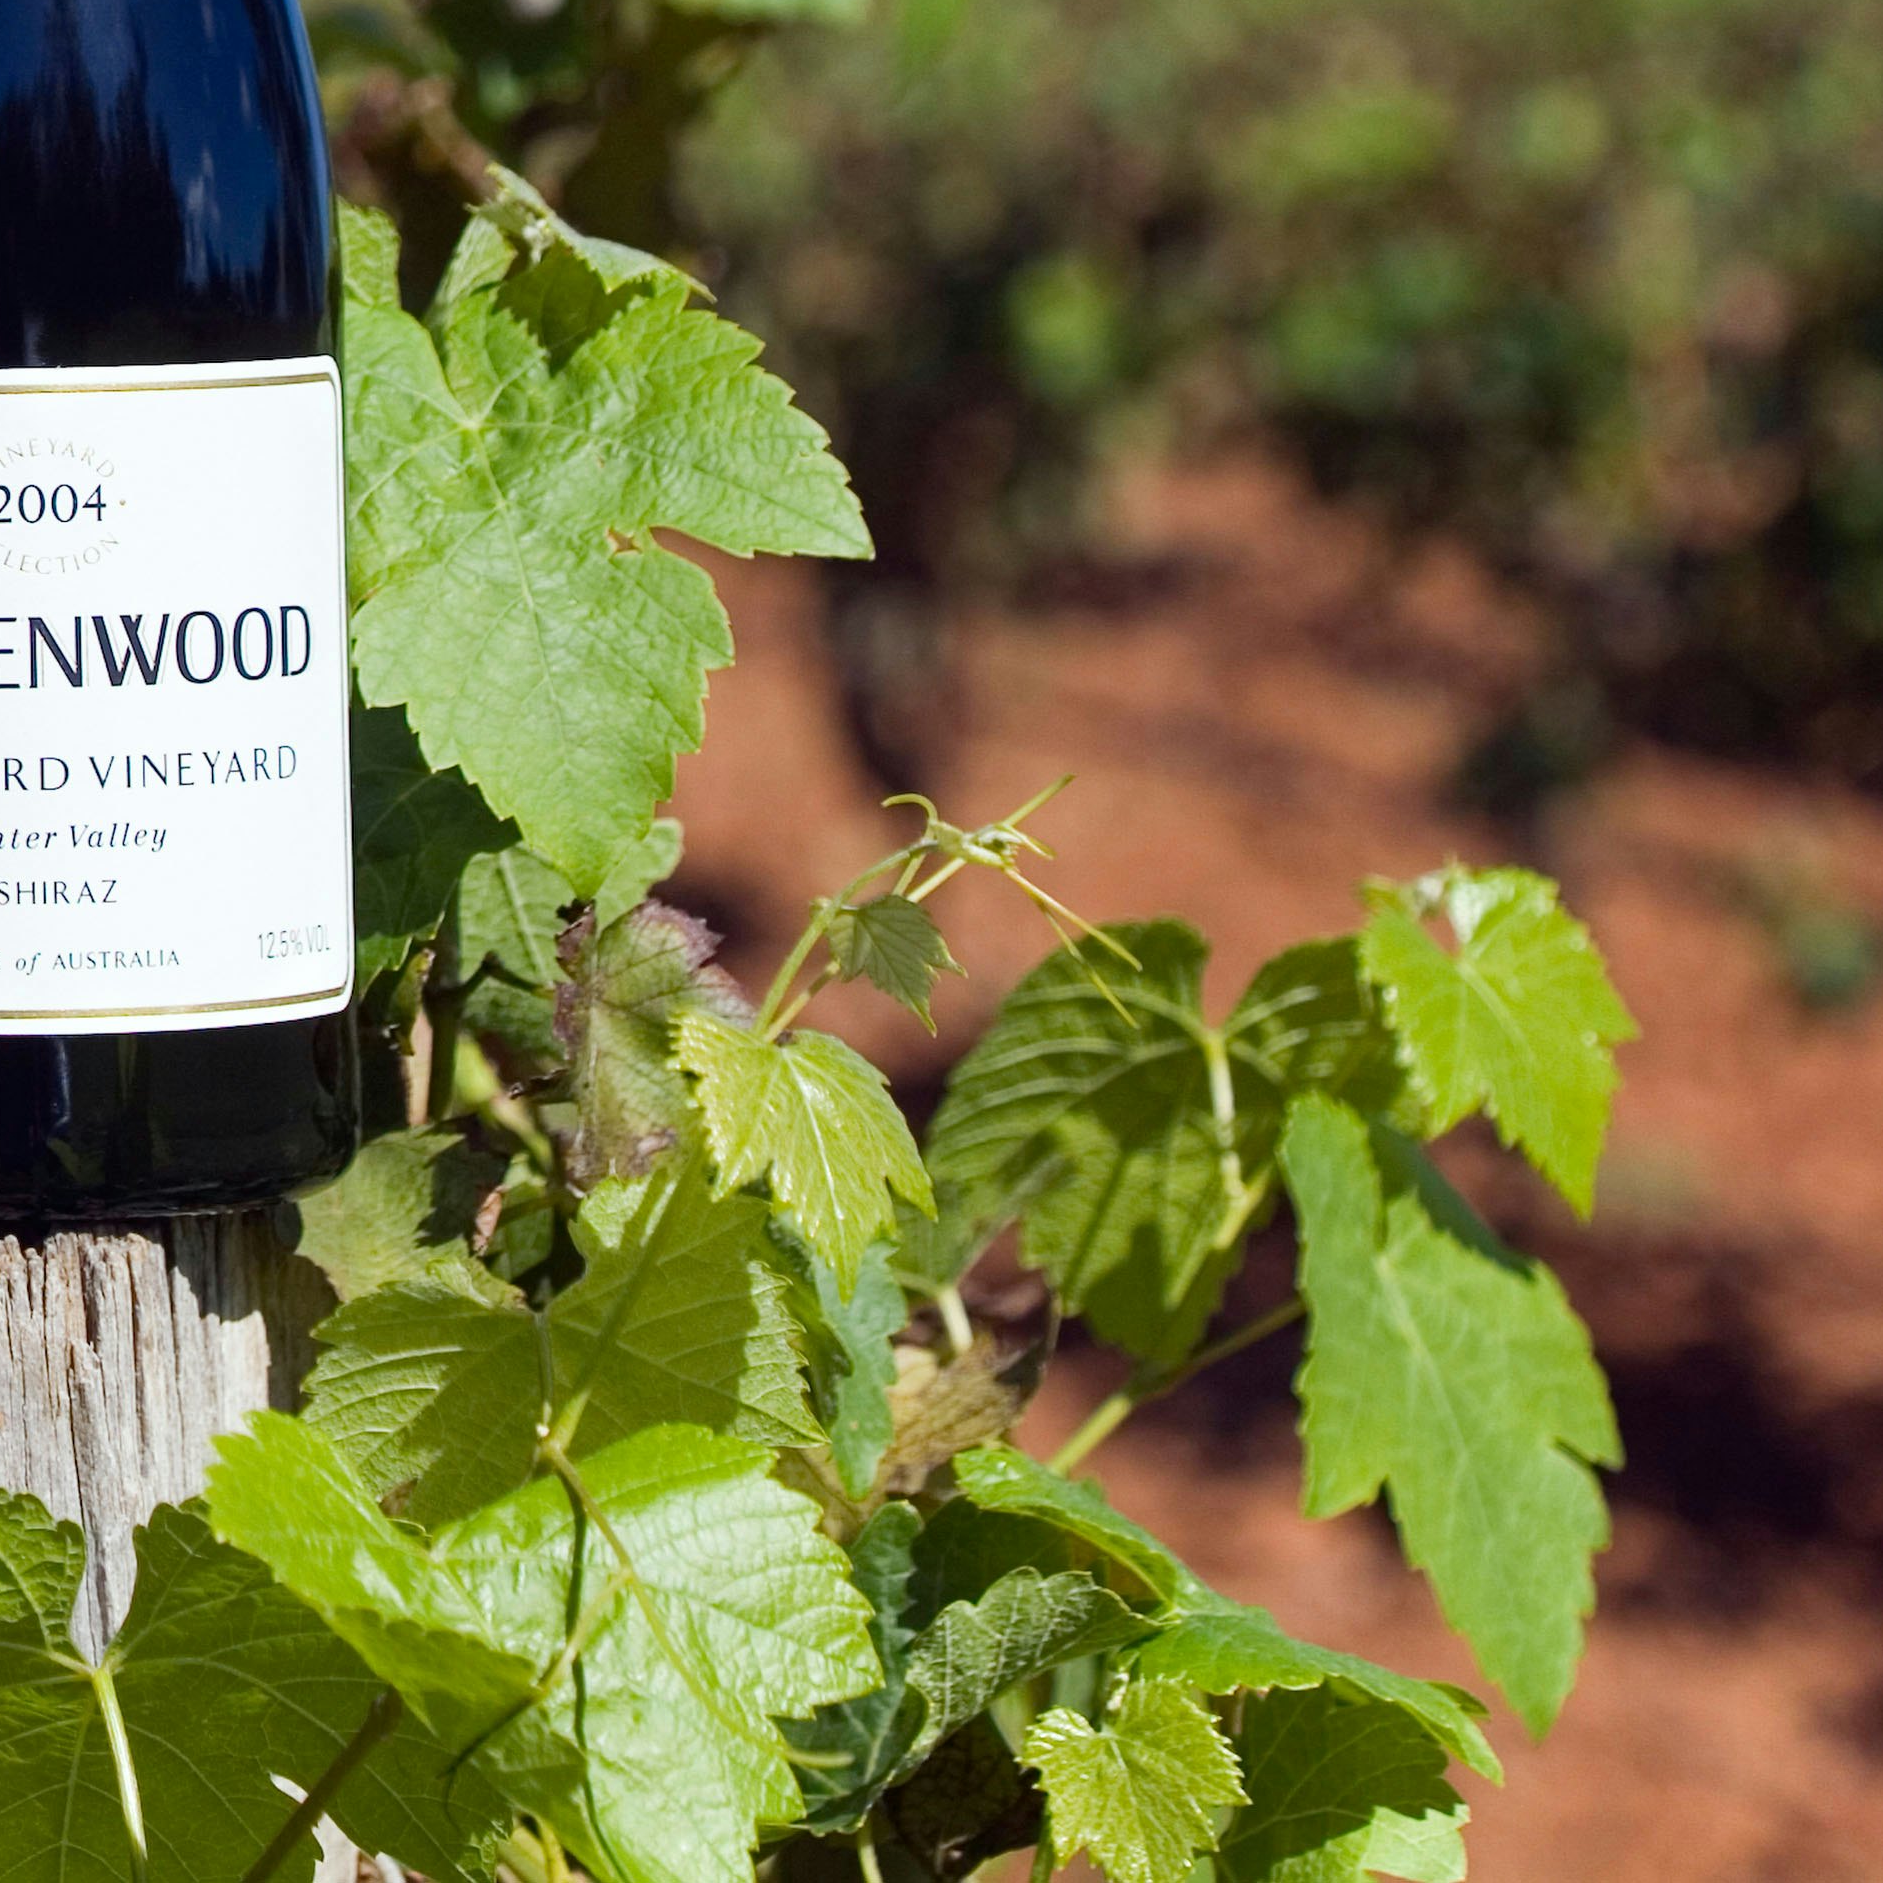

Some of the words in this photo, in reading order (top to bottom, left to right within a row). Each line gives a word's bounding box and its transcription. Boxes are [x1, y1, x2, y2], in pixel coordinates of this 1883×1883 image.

[88, 745, 298, 789] VINEYARD
[70, 822, 168, 852] Valley
[15, 951, 42, 975] of
[51, 949, 180, 971] AUSTRALIA
